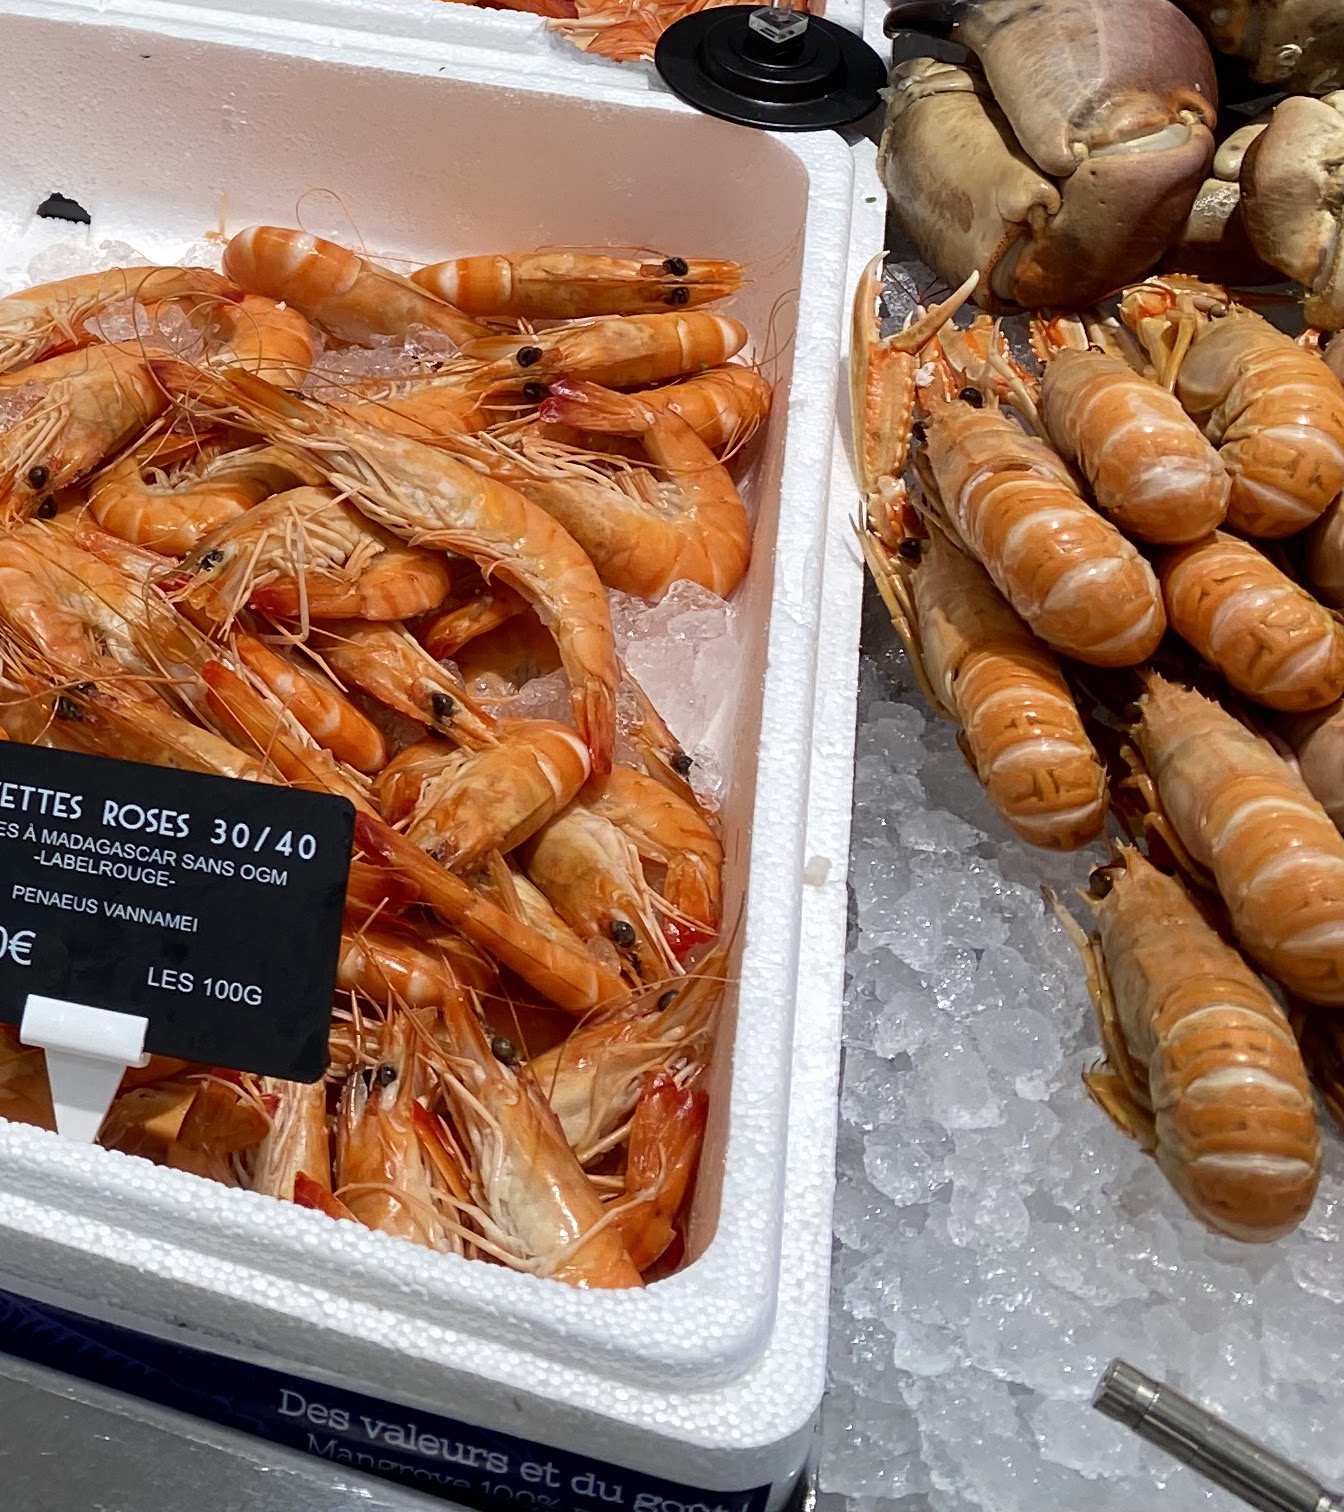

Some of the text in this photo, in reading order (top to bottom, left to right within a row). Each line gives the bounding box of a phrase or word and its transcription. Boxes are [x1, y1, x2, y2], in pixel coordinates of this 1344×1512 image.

[23, 822, 37, 841] À
[41, 829, 176, 867] MADAGASCAR
[181, 853, 235, 878] SANS
[239, 863, 288, 886] OGM
[101, 799, 190, 839] ROSES
[210, 818, 317, 861] 30/40
[34, 850, 176, 887] -LABELROUGE-
[12, 885, 198, 933] PENAEUS VANNAMEI
[147, 966, 194, 993] LES
[202, 977, 263, 1006] 100G
[276, 1389, 624, 1504] Des valeurs et du
